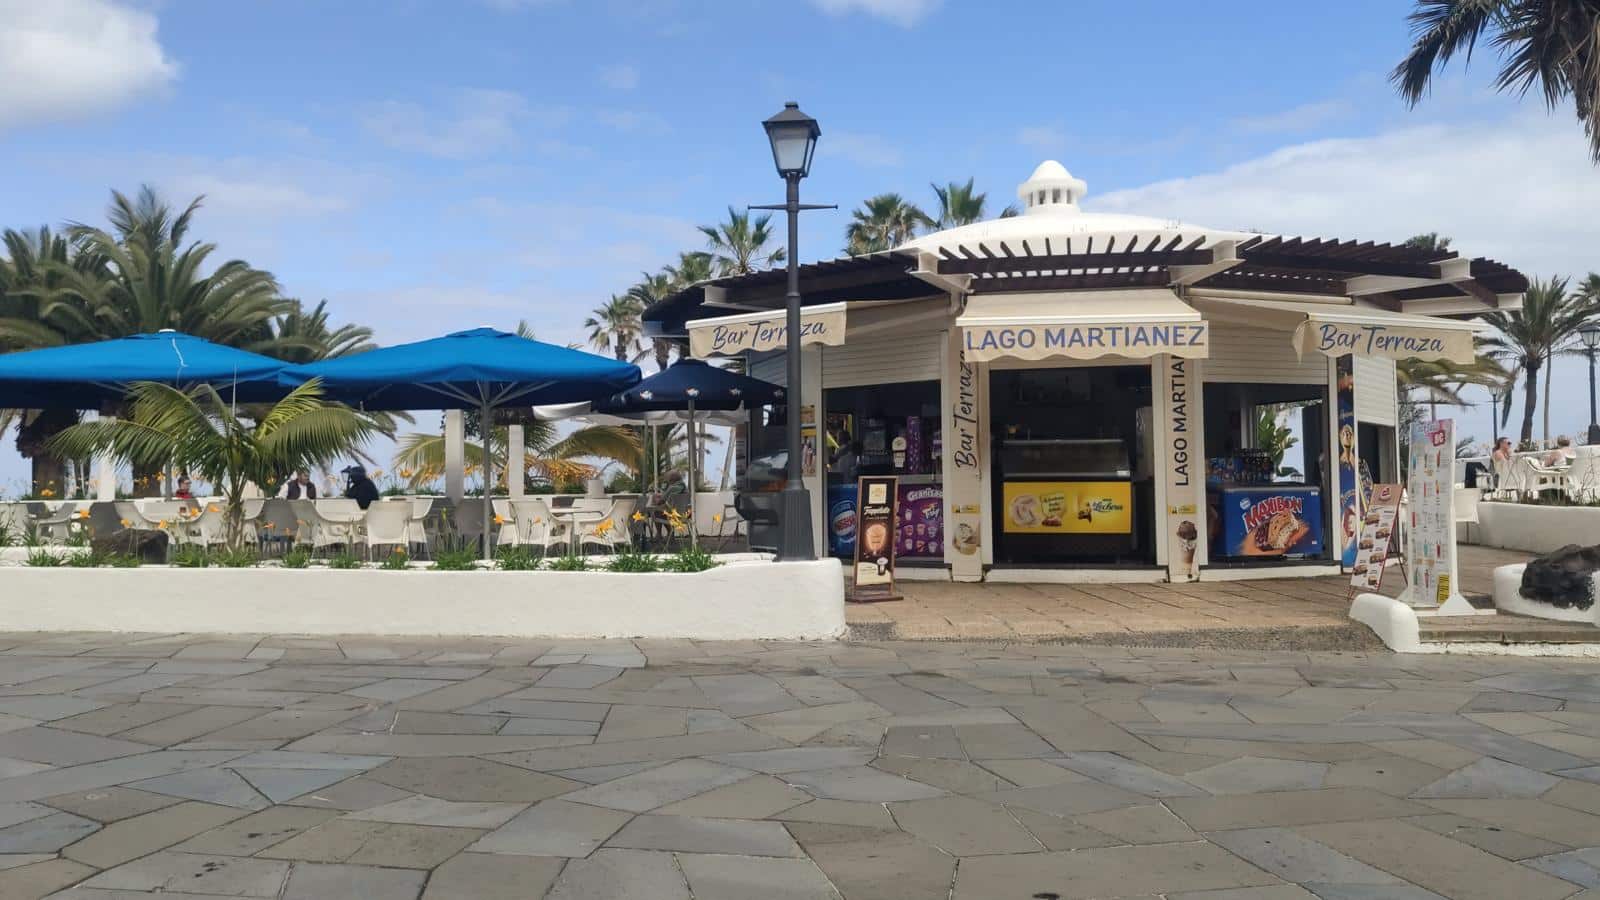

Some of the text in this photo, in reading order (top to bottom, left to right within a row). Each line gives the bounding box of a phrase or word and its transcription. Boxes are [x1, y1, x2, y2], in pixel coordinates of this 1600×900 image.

[712, 320, 826, 350] Bar Terrza
[966, 325, 1206, 351] LAGO MARTIANEZ
[1319, 324, 1445, 355] Bar Terraza
[1171, 356, 1188, 432] MARTIA
[954, 429, 978, 468] Bar
[1173, 438, 1189, 487] LAGO
[1242, 496, 1303, 533] MAXIBON
